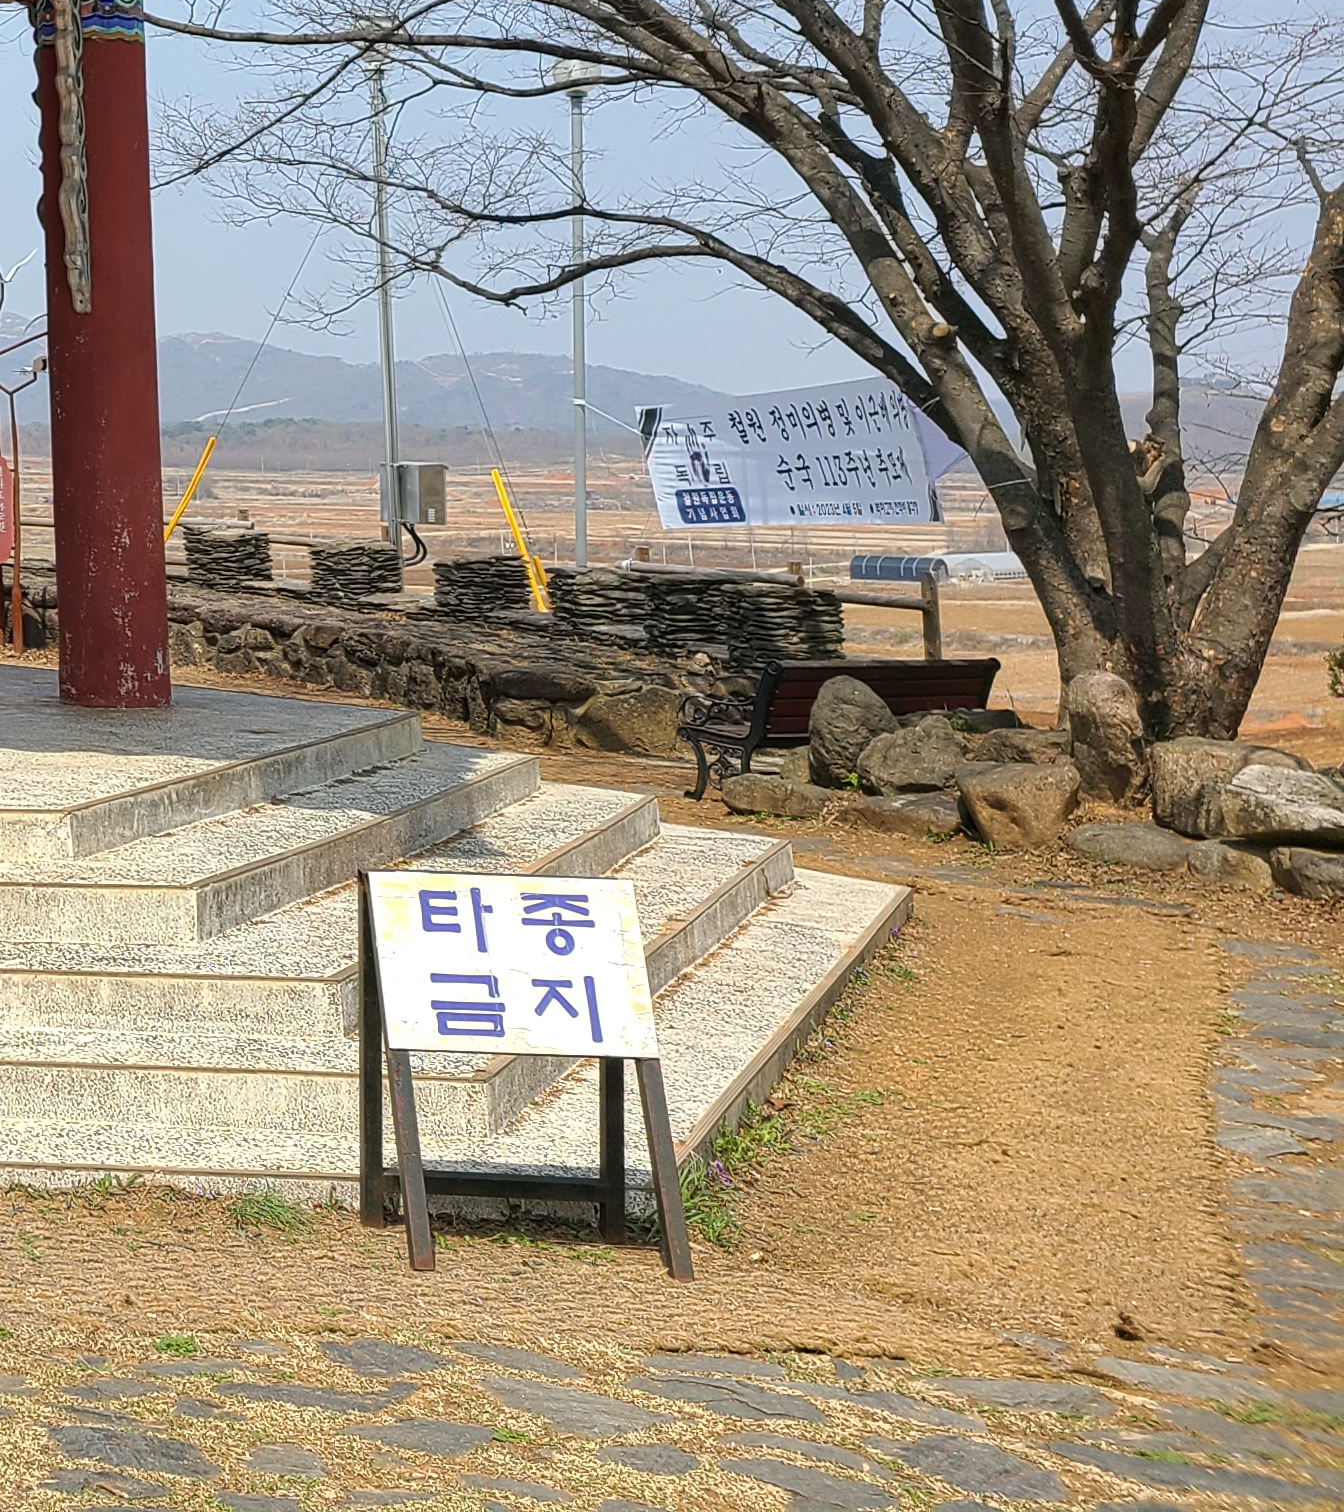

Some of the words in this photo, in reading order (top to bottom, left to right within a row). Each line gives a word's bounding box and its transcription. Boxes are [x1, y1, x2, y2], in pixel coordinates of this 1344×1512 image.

[728, 408, 767, 445] 철원
[768, 399, 836, 442] 정미의병
[835, 397, 856, 436] 및
[776, 453, 815, 491] 순국
[815, 449, 876, 489] 113주년
[686, 506, 740, 521] 기념사업회
